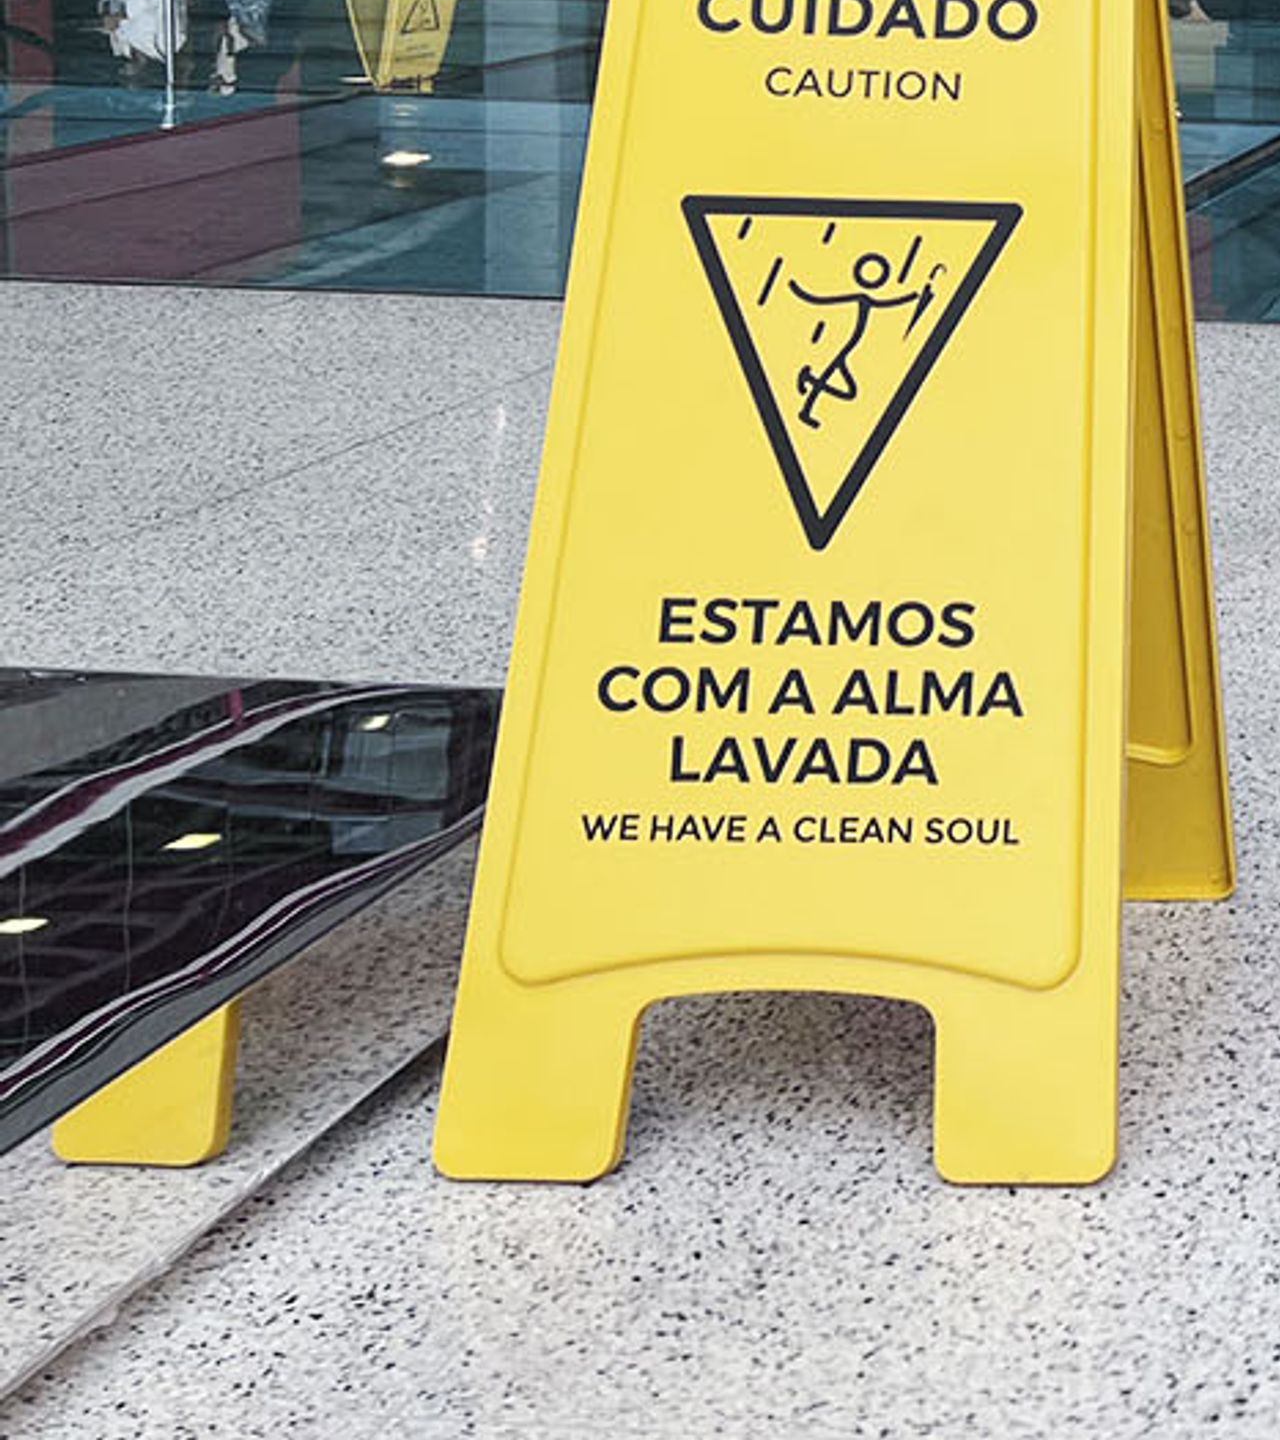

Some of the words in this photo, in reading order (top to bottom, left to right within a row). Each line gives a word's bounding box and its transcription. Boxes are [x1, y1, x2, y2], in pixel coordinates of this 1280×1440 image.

[765, 67, 961, 101] CAUTION
[658, 597, 976, 648] ESTAMOS
[597, 665, 750, 714] COM
[767, 668, 816, 715] A
[831, 669, 1024, 718] ALMA
[670, 735, 939, 786] LAVADA
[581, 814, 641, 841] WE
[649, 814, 747, 843] HAVE
[756, 816, 782, 843] A
[793, 816, 913, 844] CLEAN
[924, 817, 1019, 845] SOUL
